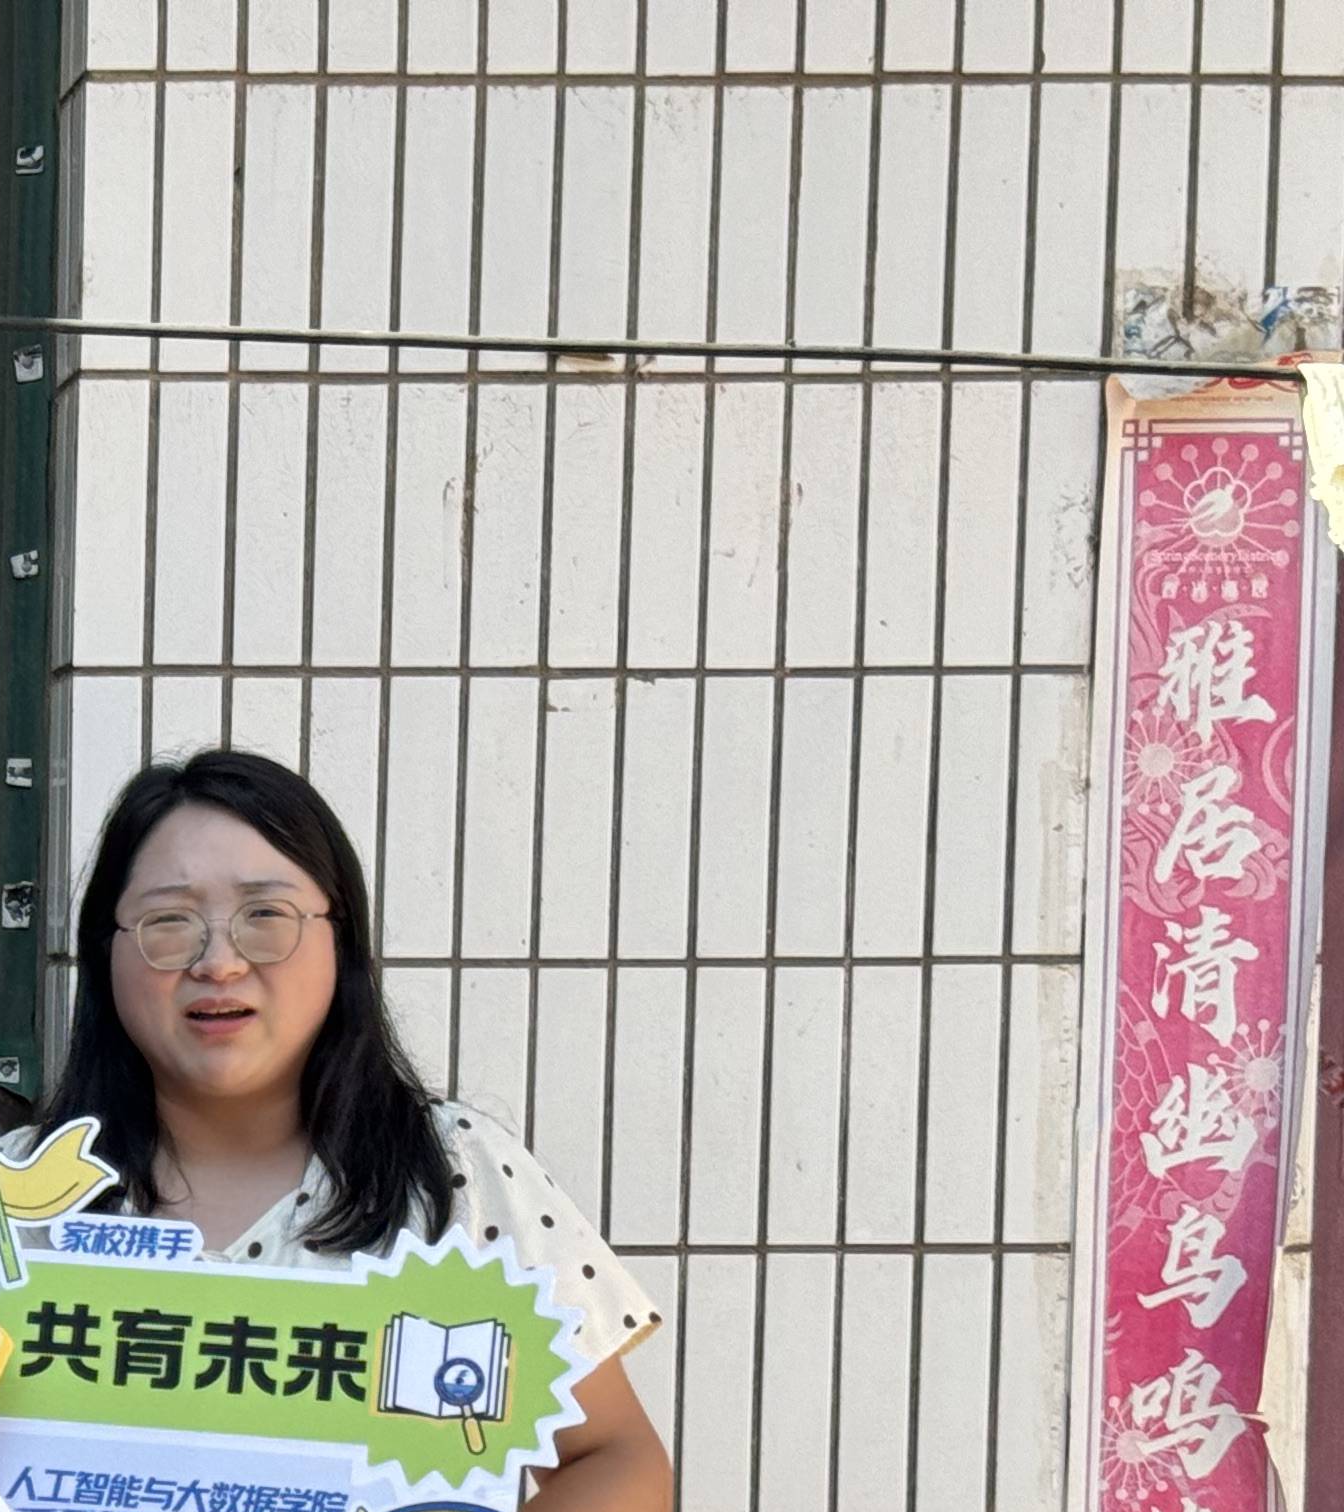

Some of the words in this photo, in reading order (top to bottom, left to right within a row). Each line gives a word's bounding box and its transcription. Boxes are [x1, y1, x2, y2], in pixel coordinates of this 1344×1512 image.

[59, 1221, 194, 1260] 家校携手
[20, 1301, 367, 1402] 共育未来
